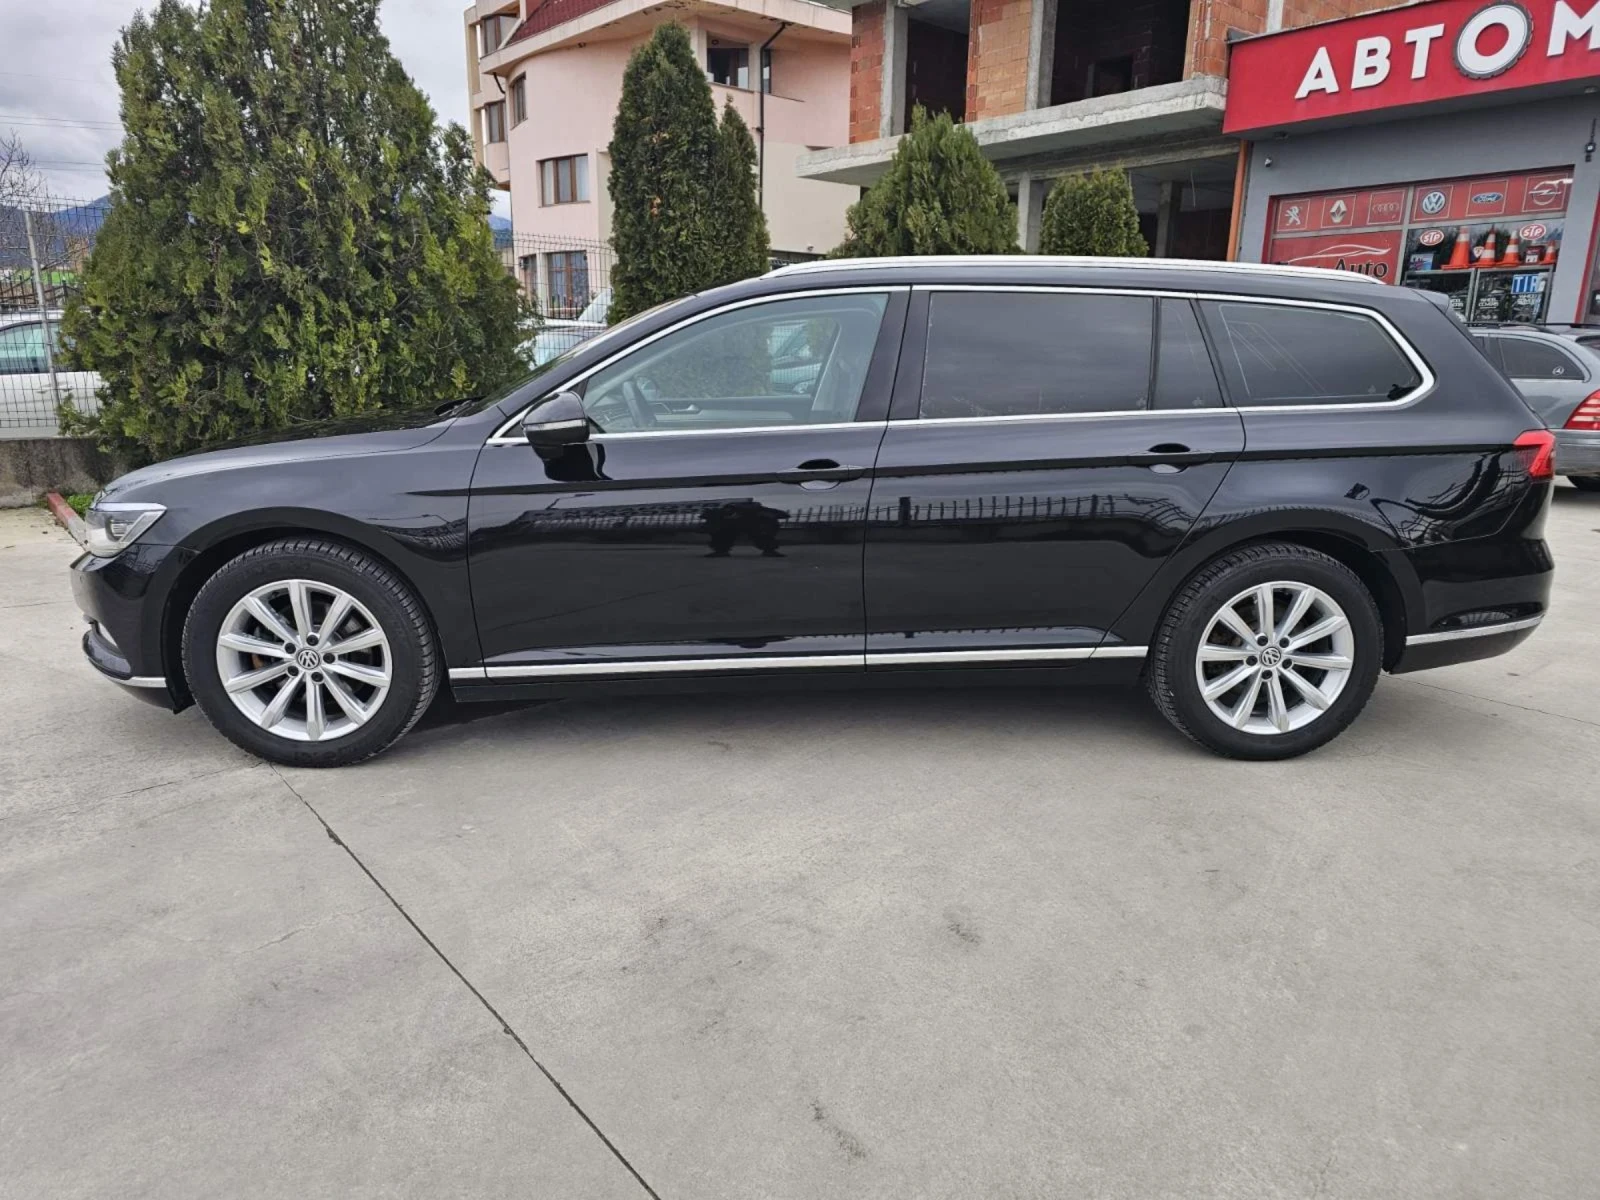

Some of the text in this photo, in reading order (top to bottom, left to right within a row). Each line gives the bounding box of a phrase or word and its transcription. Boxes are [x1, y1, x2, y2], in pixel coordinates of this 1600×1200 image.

[1423, 231, 1443, 244] STP
[1522, 225, 1543, 237] STP
[1335, 257, 1388, 278] Auto
